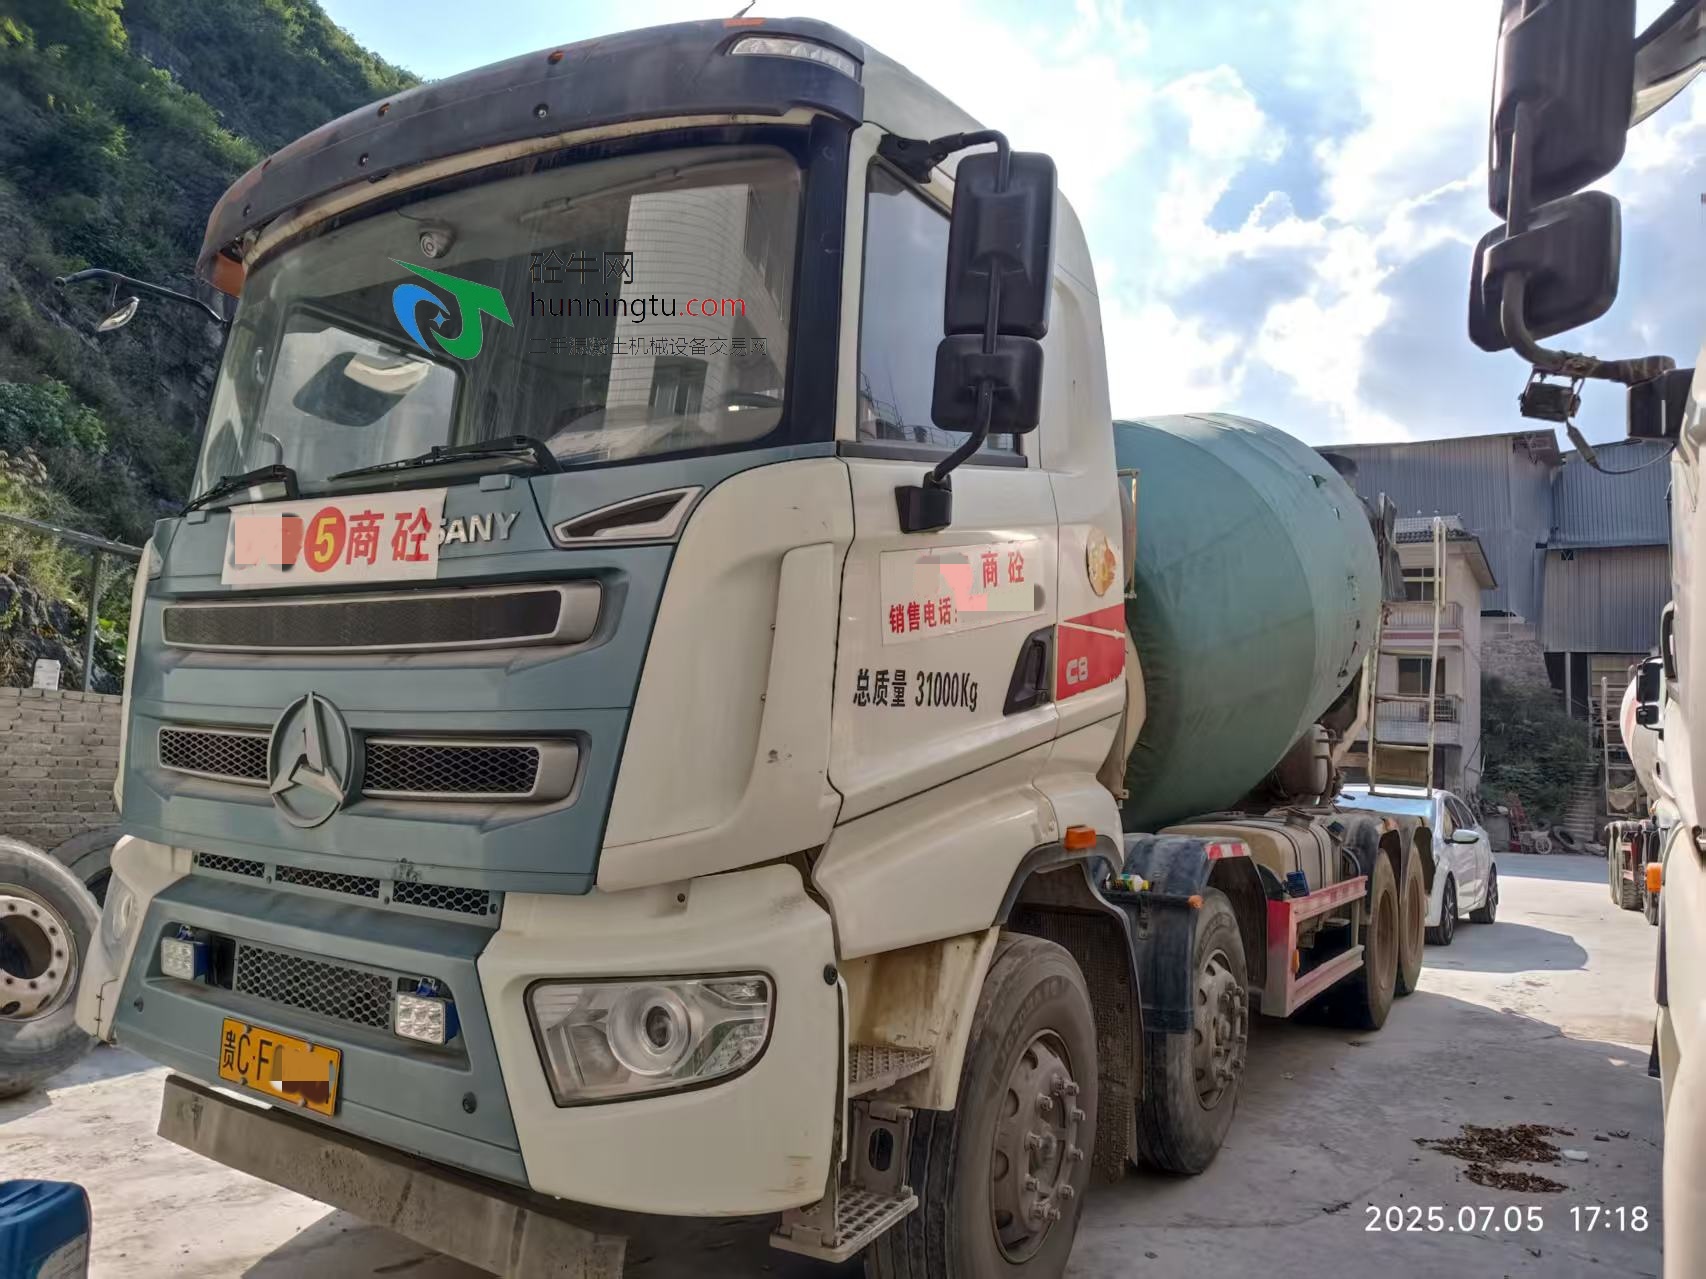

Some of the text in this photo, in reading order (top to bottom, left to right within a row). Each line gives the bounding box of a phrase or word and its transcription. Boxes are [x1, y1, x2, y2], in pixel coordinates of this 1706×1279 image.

[853, 668, 979, 712] 总质量 31000Kg
